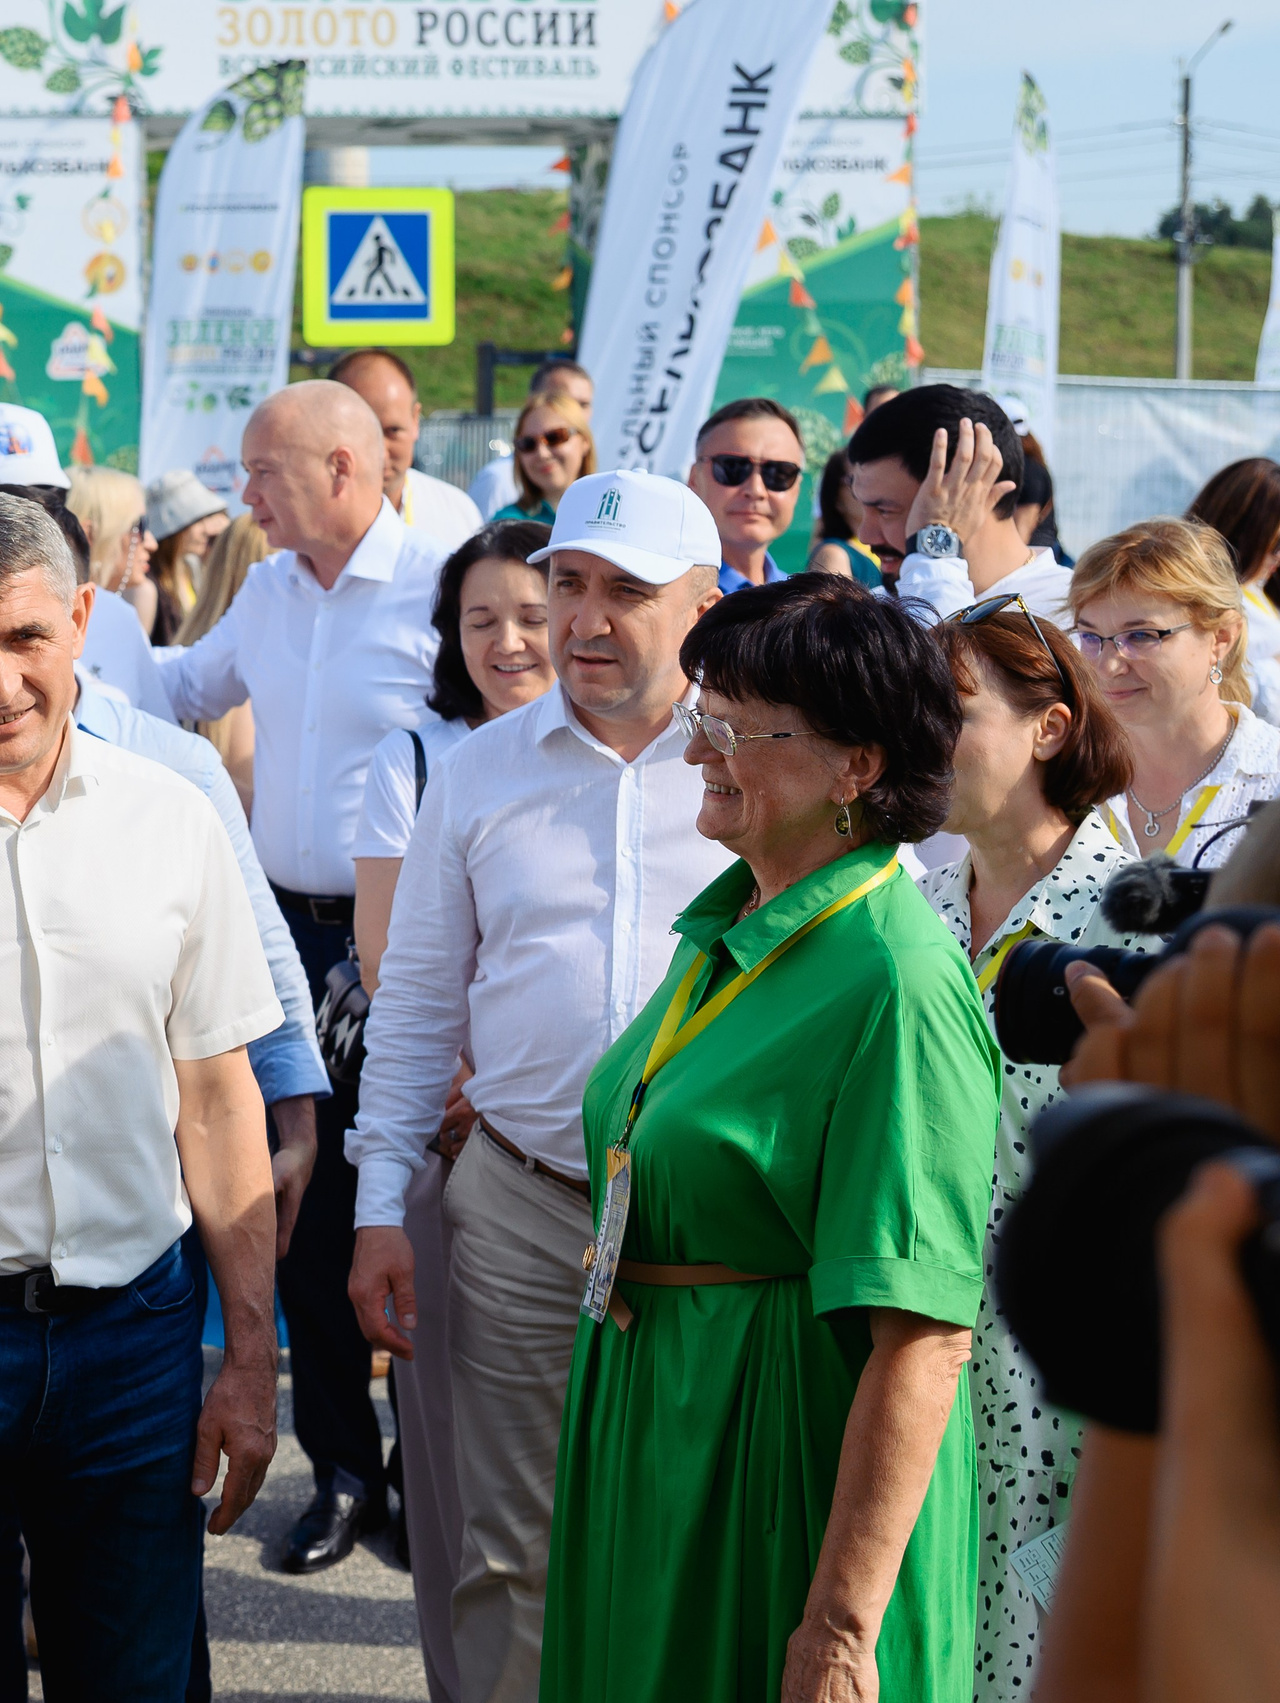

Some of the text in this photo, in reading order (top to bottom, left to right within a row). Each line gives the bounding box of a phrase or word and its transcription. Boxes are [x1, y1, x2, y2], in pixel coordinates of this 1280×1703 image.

[217, 8, 599, 47] ЗОЛОТО РОССИИ
[219, 52, 601, 80] ВСЕСИЙСКИЙ ФЕСТИВАЛЬ
[644, 141, 691, 309] СПОНСОР
